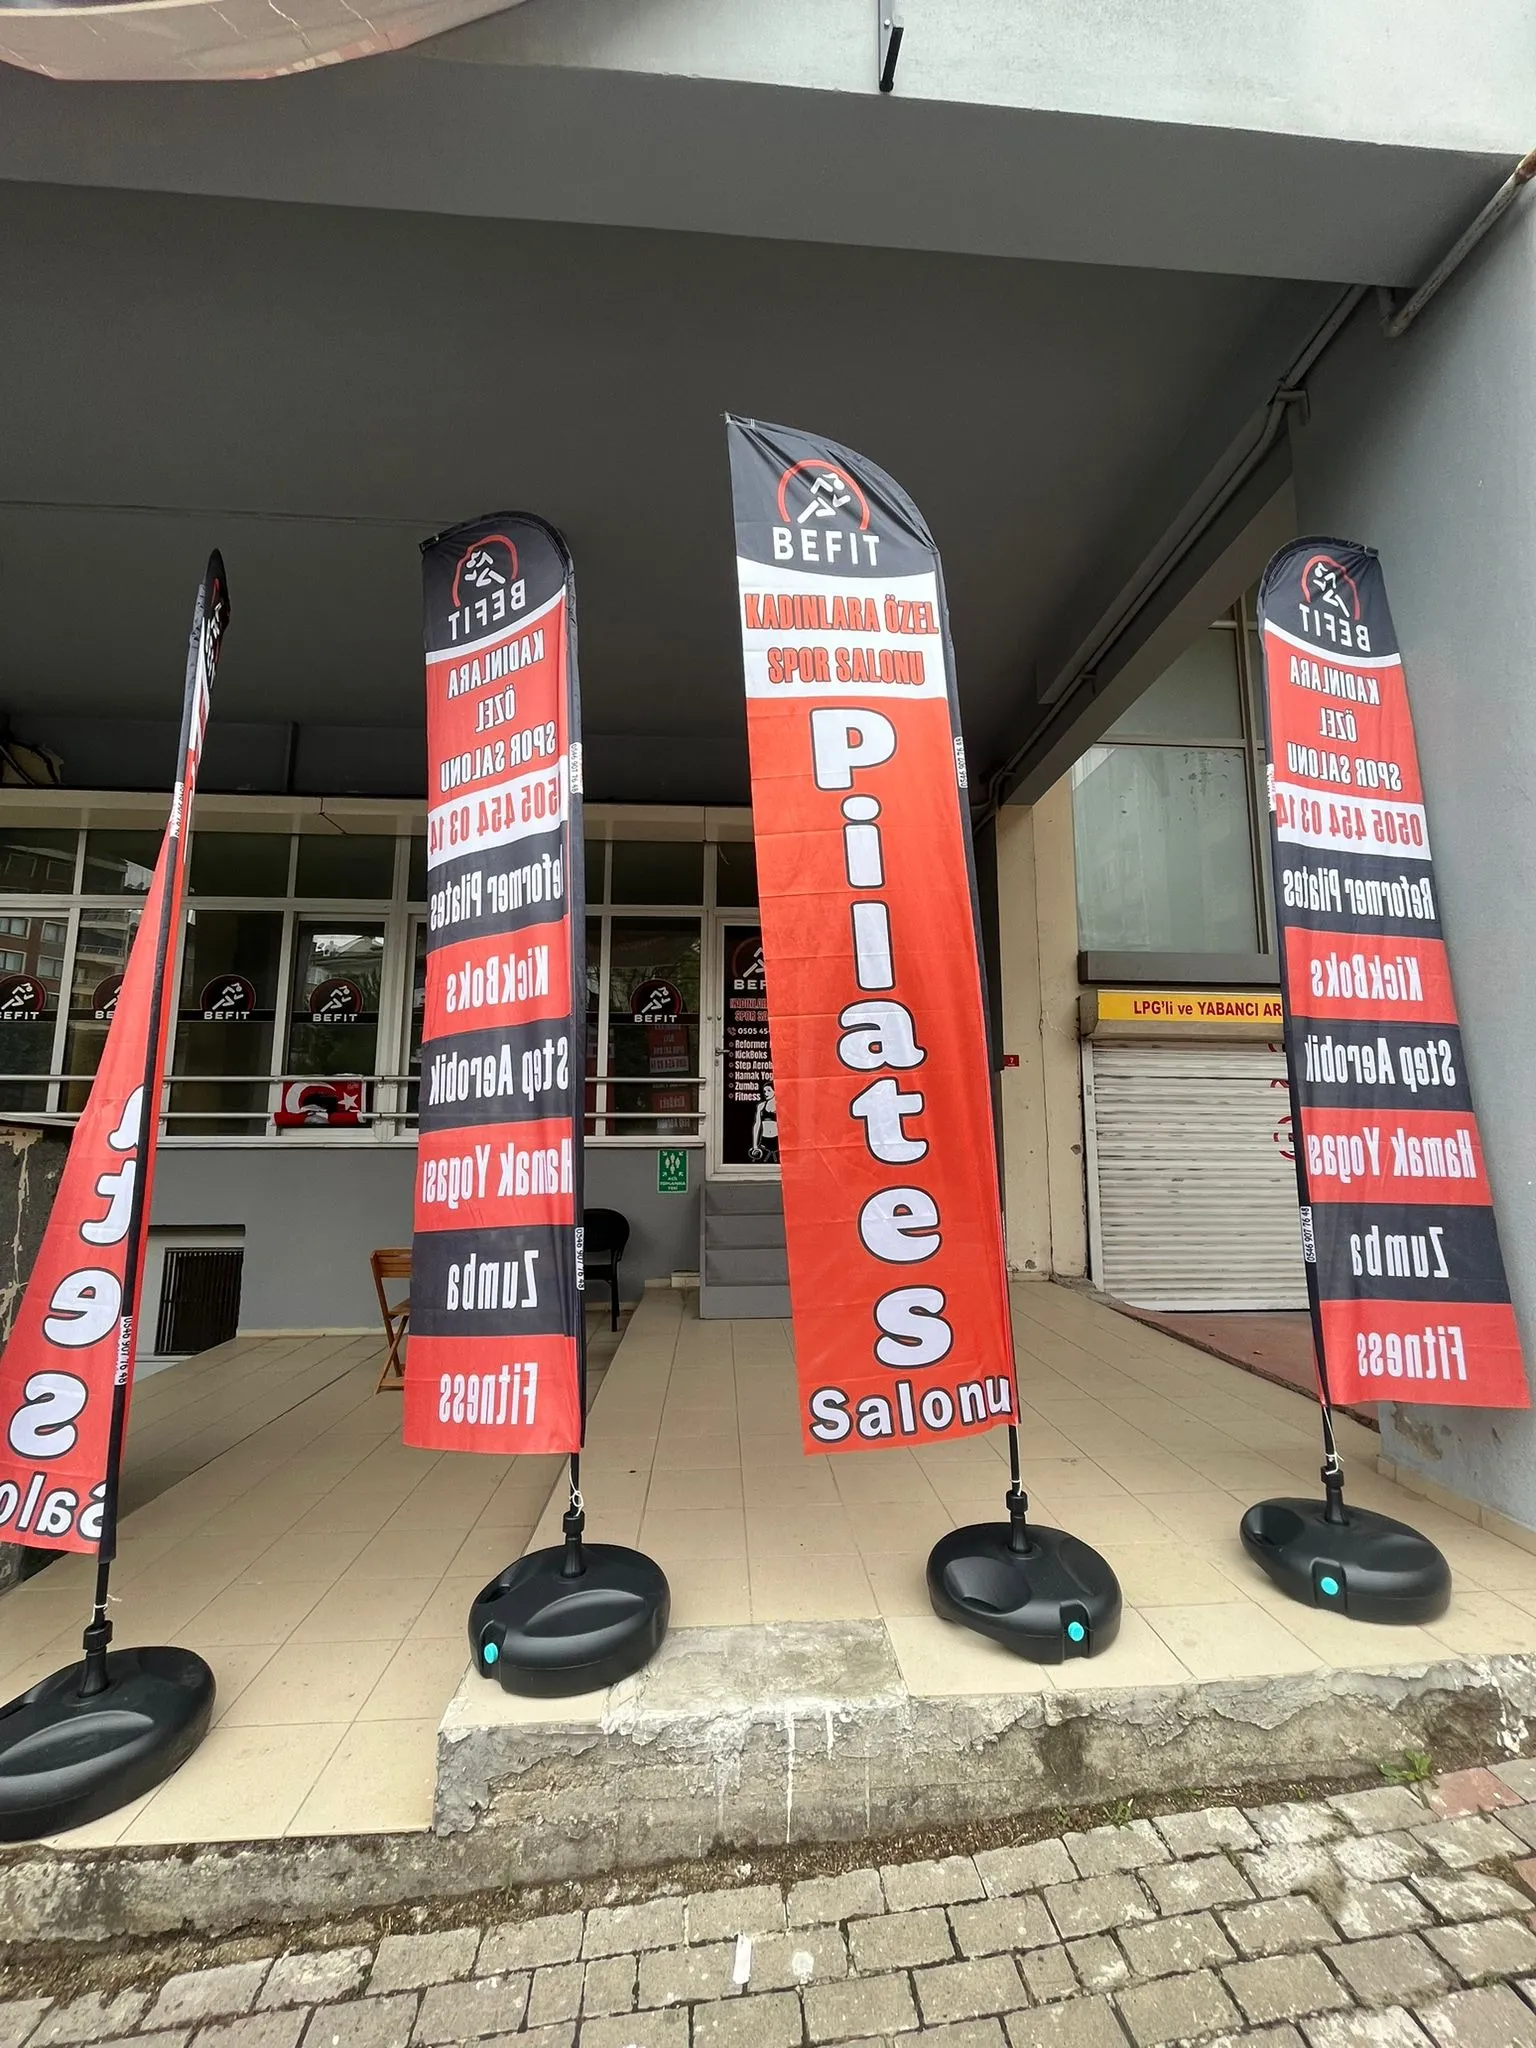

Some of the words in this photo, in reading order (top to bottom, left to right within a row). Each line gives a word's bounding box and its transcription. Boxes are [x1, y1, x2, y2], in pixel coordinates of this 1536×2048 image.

[773, 527, 880, 566] BEFIT
[744, 593, 880, 632] KADINLARA
[884, 594, 939, 634] ÖZEL
[767, 647, 830, 683] SPOR
[835, 647, 925, 685] SALONU
[0, 1011, 40, 1020] EFIT
[204, 1011, 251, 1020] BEFIT
[1177, 1006, 1193, 1015] ve
[1197, 1002, 1259, 1017] YABANCI
[312, 1013, 358, 1022] BEFIT
[634, 1014, 677, 1023] BEFIT
[737, 1027, 756, 1035] 0505
[809, 707, 954, 1369] Pilates
[1302, 1218, 1311, 1227] 76
[1303, 1229, 1313, 1242] 907
[1305, 1243, 1315, 1262] 0546
[808, 1375, 1013, 1444] Salonu
